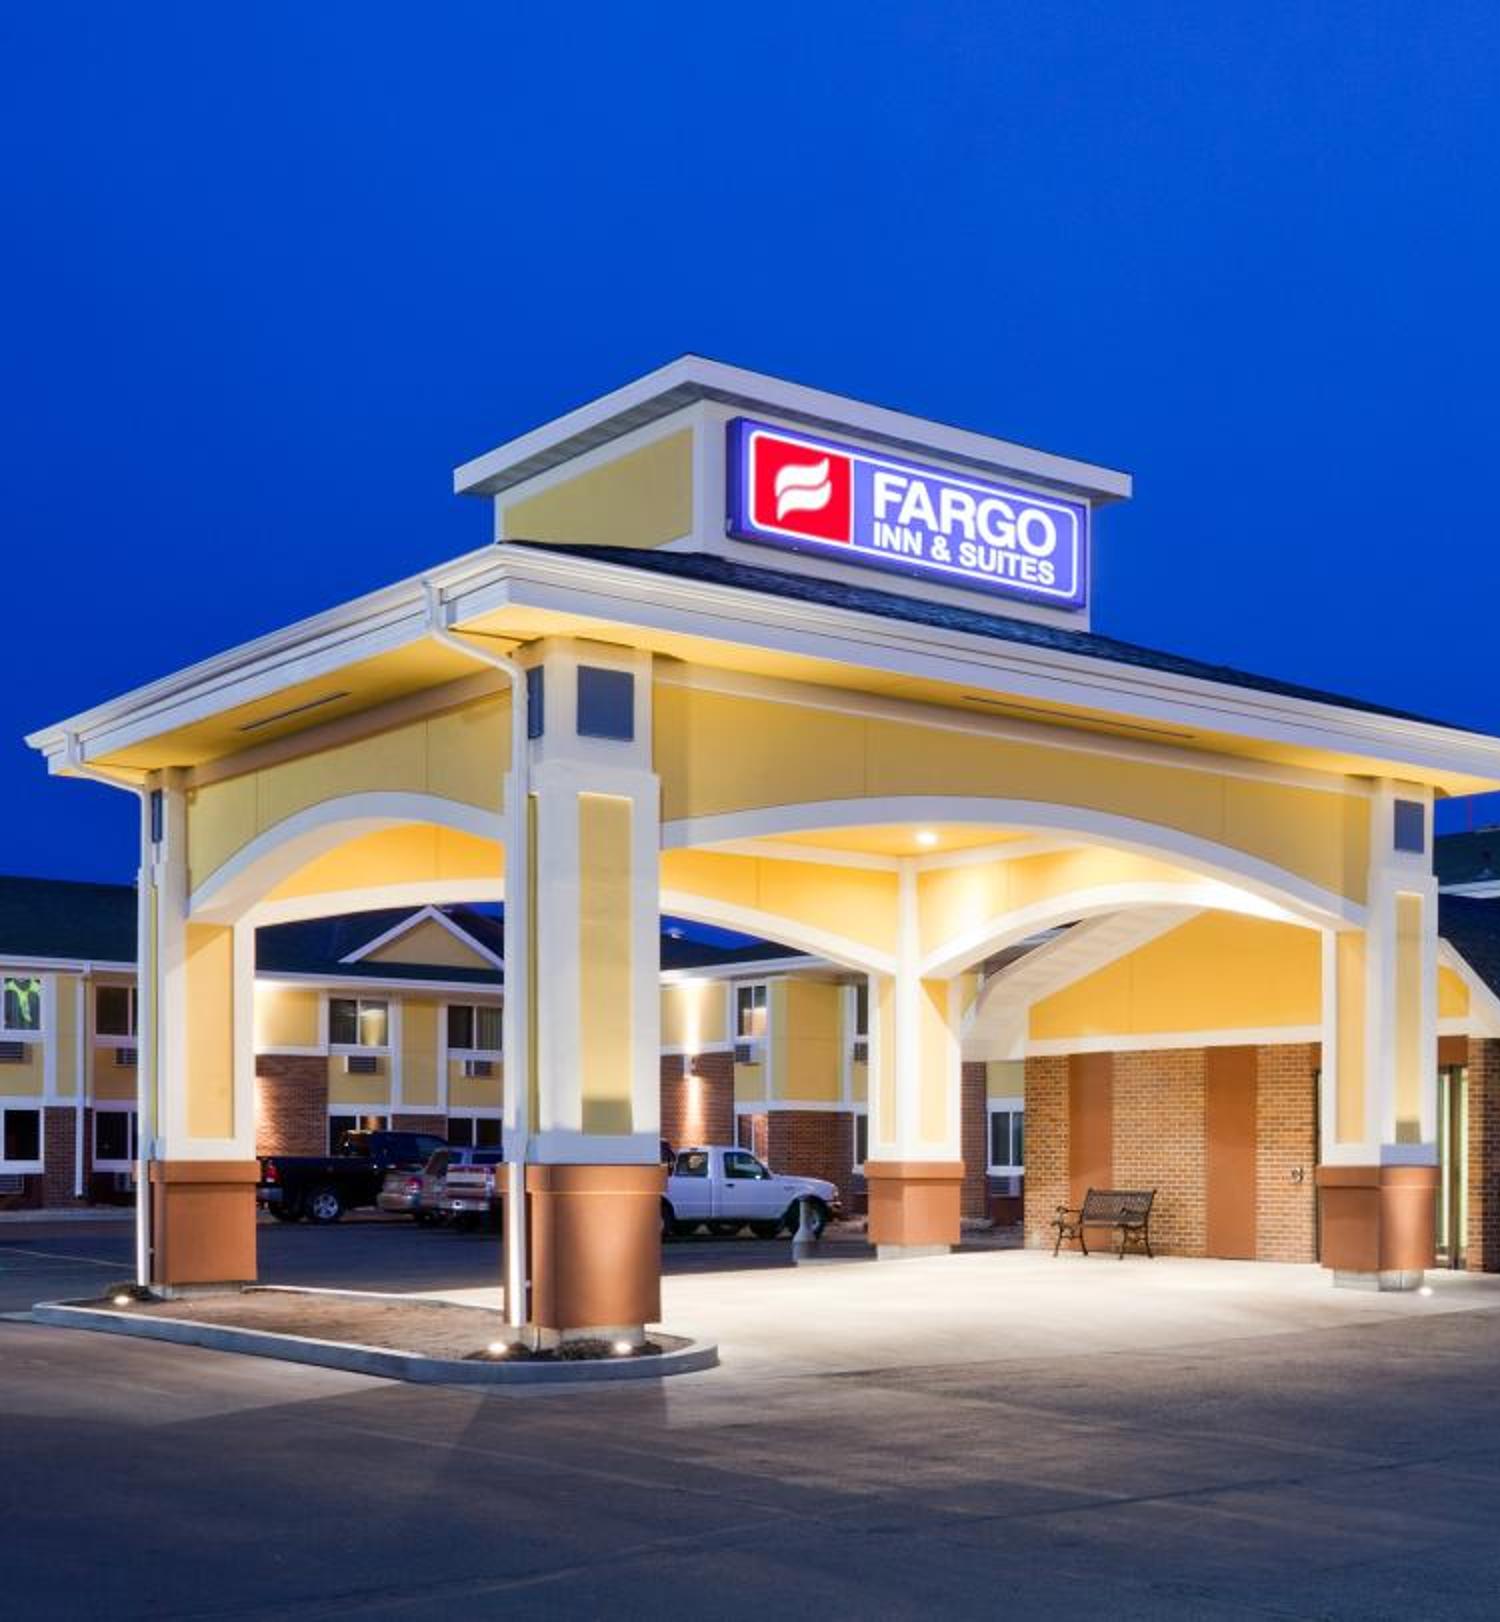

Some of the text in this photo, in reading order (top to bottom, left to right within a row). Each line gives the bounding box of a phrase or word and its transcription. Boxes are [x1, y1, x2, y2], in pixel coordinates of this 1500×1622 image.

[872, 471, 1057, 557] FARGO
[873, 521, 1055, 585] INN & SUITES
